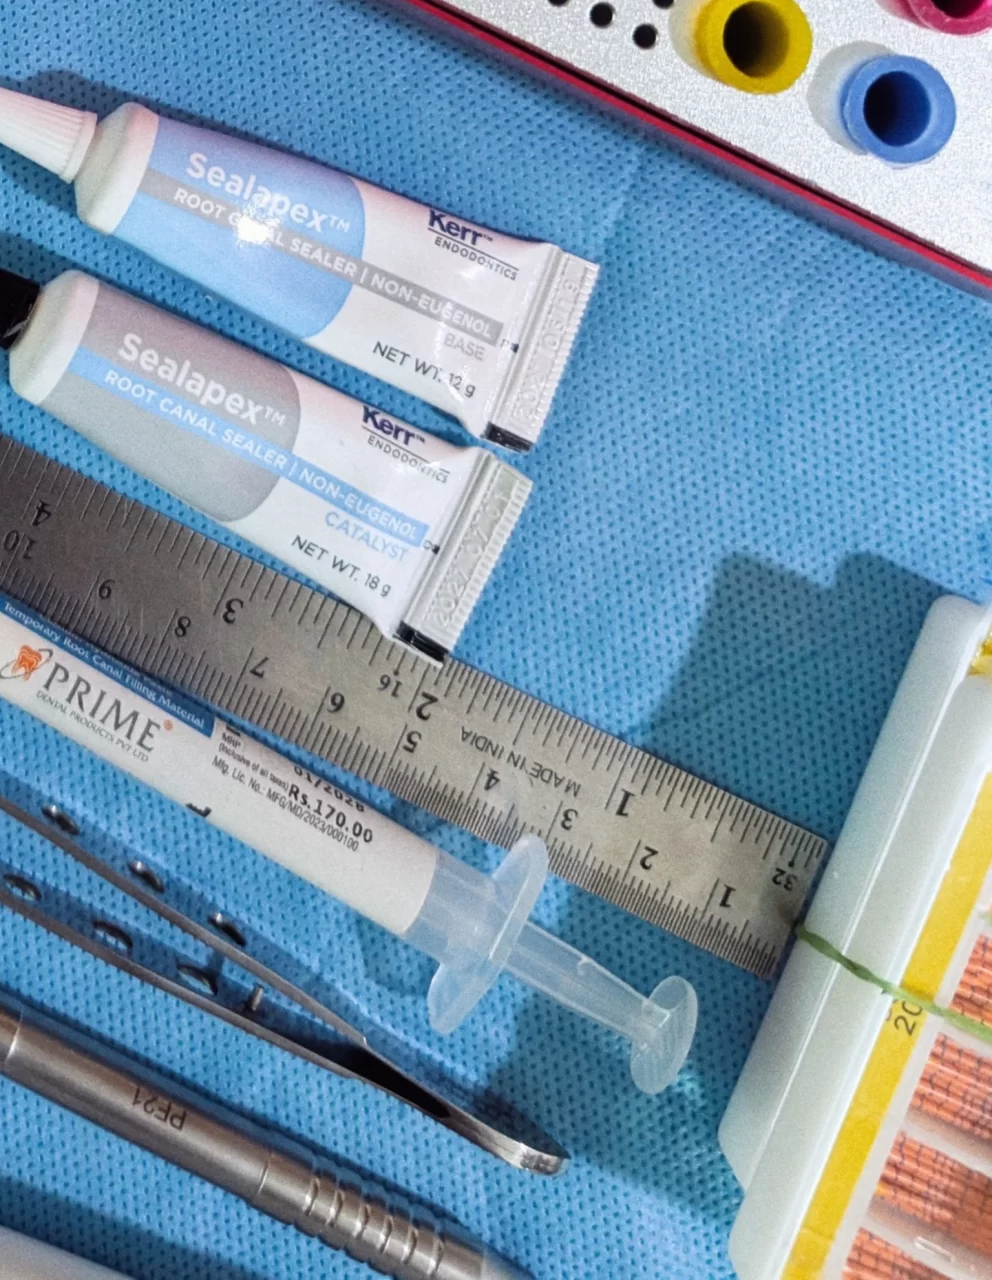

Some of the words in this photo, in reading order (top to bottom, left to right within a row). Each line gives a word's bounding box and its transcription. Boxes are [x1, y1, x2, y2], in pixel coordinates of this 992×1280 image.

[173, 187, 226, 218] ROOT
[289, 237, 359, 276] SEALER
[371, 274, 490, 338] NON-EUGENOL
[434, 235, 516, 280] ENDODONTICS
[442, 333, 484, 362] BASE
[372, 341, 410, 365] NET
[414, 358, 441, 382] WT.
[465, 382, 477, 398] g
[104, 369, 156, 402] ROOT
[159, 397, 216, 436] CANAL
[221, 428, 287, 473] SEALER
[300, 468, 417, 540] NON-EUGENOL
[367, 434, 447, 483] ENDODONTICS
[29, 501, 51, 527] 4
[0, 528, 39, 560] 10
[324, 510, 407, 560] CATALYST
[292, 535, 327, 559] NET
[331, 555, 360, 578] WT.
[367, 572, 382, 590] 18
[380, 584, 392, 598] g
[95, 579, 112, 600] 9
[222, 598, 244, 624] 3
[171, 616, 193, 637] 8
[4, 602, 60, 642] Temporary
[62, 637, 90, 659] Root
[91, 654, 126, 679] Canal
[124, 674, 156, 701] Filling
[157, 695, 204, 728] Material
[249, 652, 272, 678] 7
[379, 674, 402, 698] 16
[44, 663, 167, 751] PRIME
[330, 692, 345, 713] 6
[415, 692, 438, 721] 2
[36, 690, 67, 714] DENTAL
[69, 710, 114, 742] PRODUCTS
[115, 737, 132, 752] PVT
[402, 727, 424, 753] 5
[461, 726, 504, 759] INDIA
[212, 755, 229, 775] Mfg.
[506, 750, 526, 770] IN
[484, 769, 500, 791] 4
[528, 762, 581, 797] MADE
[288, 784, 373, 843] Rs.170.00
[615, 790, 633, 817] 1
[560, 808, 578, 831] 3
[636, 846, 660, 872] 2
[769, 866, 796, 891] 32
[715, 886, 738, 908] 1
[128, 1085, 191, 1132] PF21
